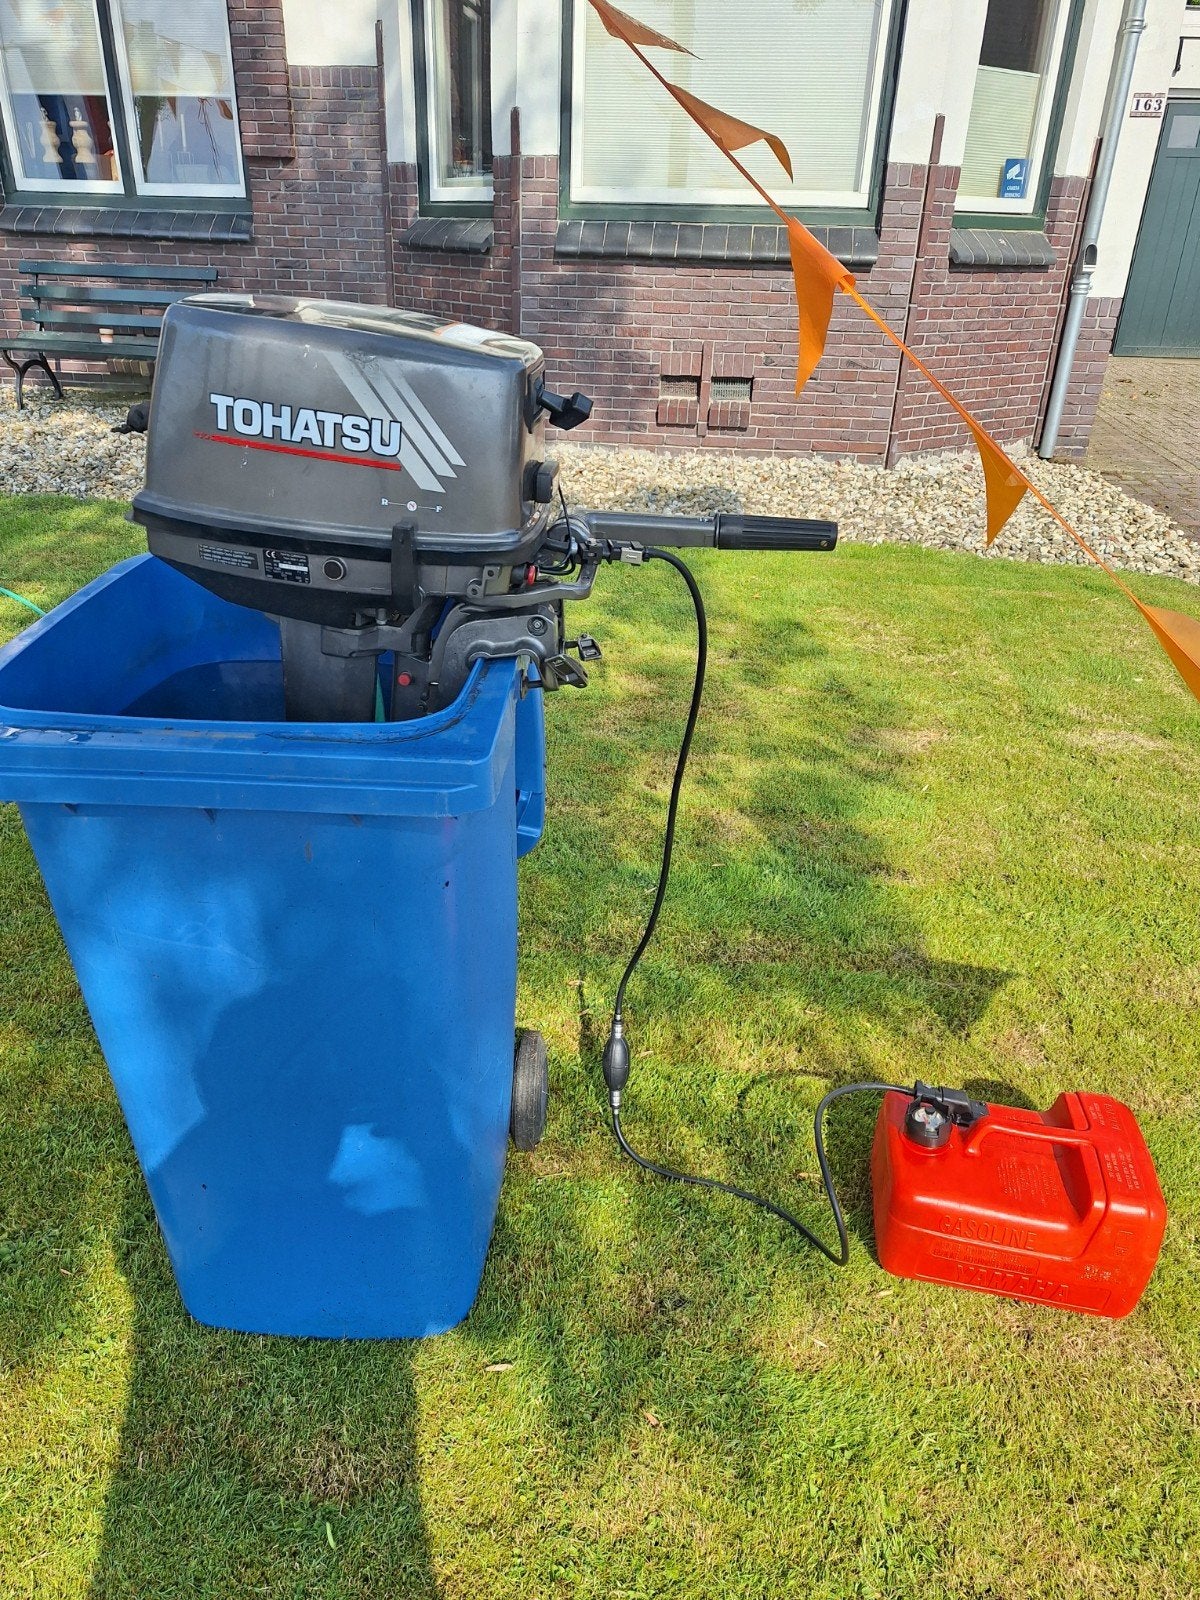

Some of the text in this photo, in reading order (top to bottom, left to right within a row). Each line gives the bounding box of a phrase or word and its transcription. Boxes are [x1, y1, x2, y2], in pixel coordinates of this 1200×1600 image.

[1134, 99, 1162, 111] 163
[210, 393, 402, 457] TOHATSU
[381, 498, 389, 506] R
[436, 505, 443, 513] F
[938, 1214, 1037, 1250] GASOLINE
[955, 1265, 1070, 1303] YAMAHA
